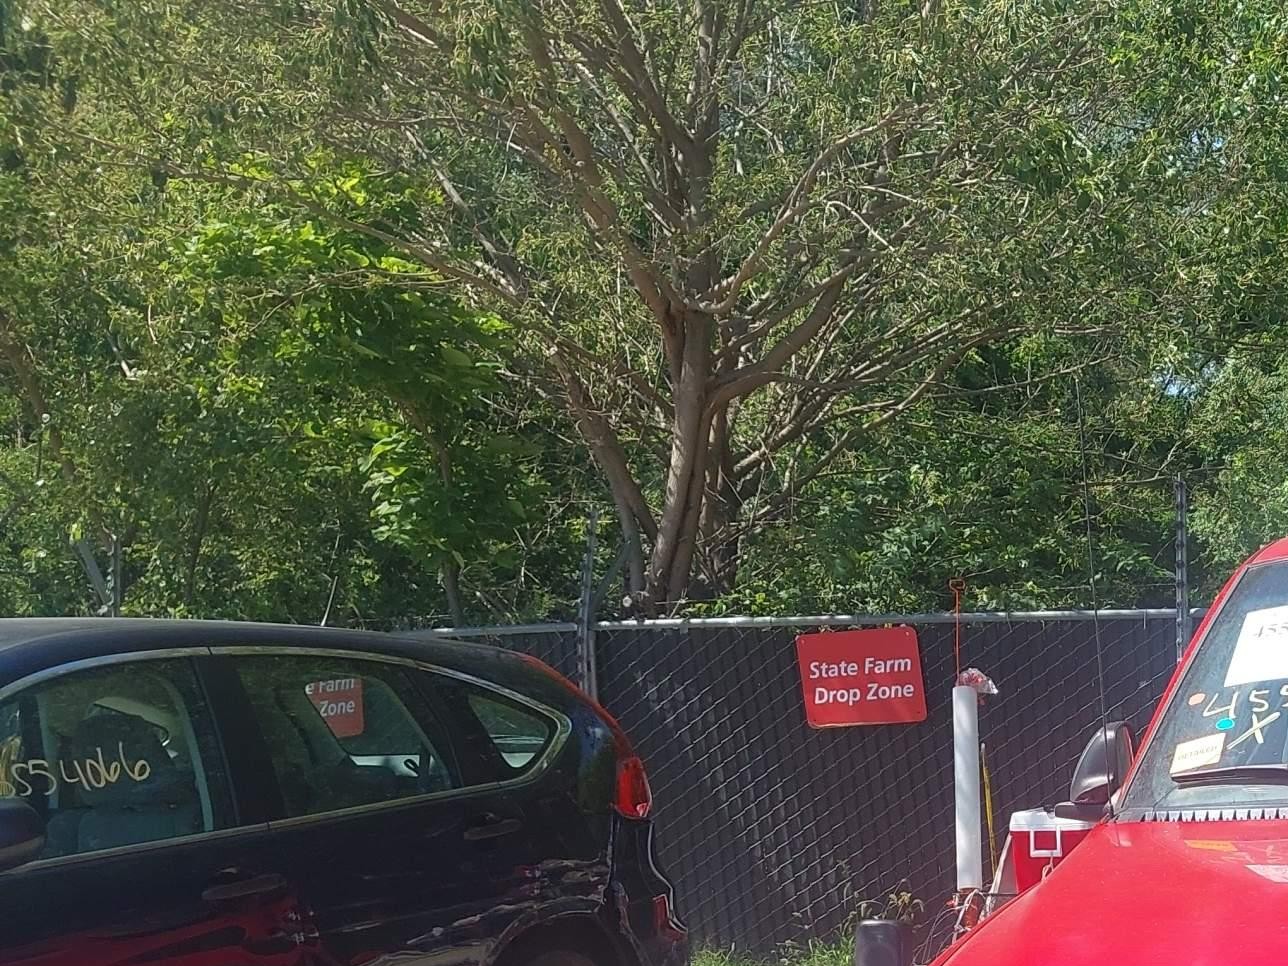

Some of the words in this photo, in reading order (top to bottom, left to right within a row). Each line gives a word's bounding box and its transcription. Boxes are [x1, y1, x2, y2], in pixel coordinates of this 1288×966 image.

[809, 660, 858, 679] State
[864, 657, 912, 675] Farm
[814, 686, 861, 707] Drop
[866, 683, 915, 701] Zone
[320, 699, 356, 717] Zone
